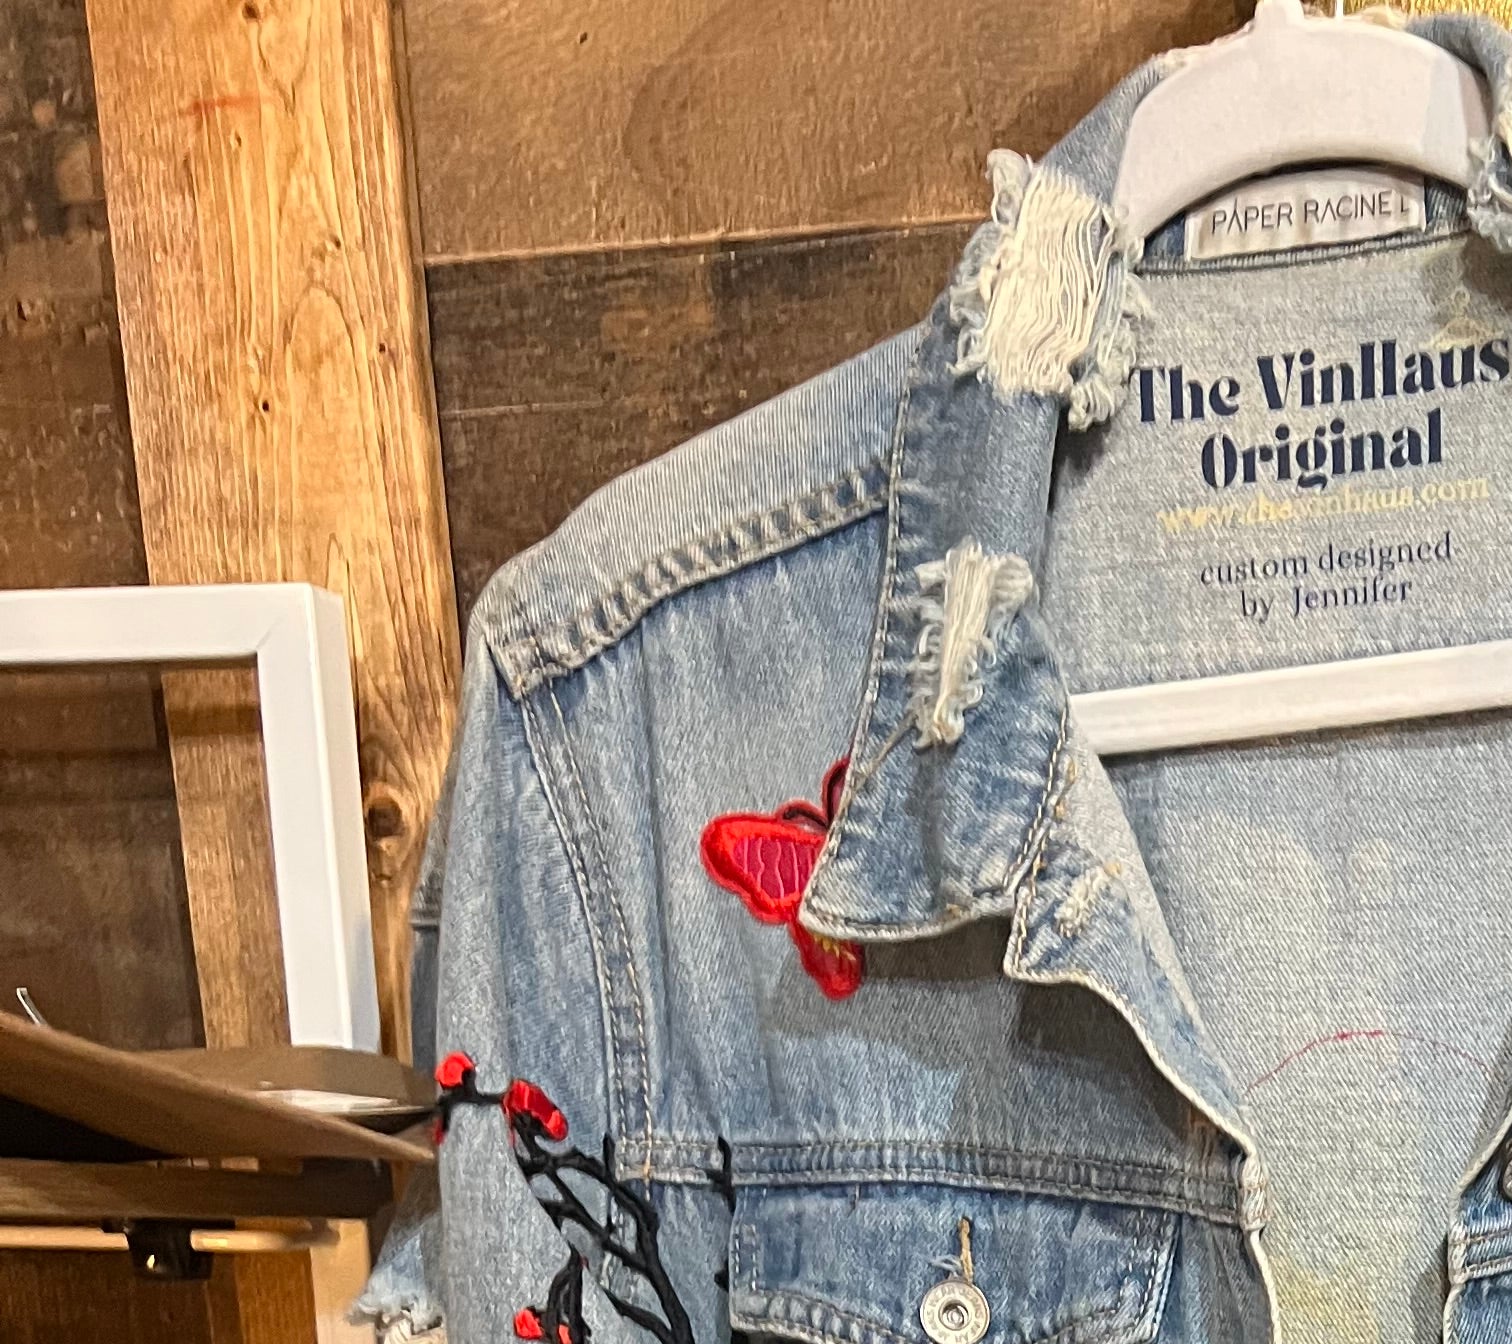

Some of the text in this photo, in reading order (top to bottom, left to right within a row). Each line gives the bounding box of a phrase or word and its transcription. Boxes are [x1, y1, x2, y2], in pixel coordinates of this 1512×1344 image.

[1211, 197, 1294, 236] PAPER
[1303, 188, 1393, 226] RACINE
[1127, 364, 1241, 424] The
[1200, 406, 1443, 491] Original
[1199, 529, 1453, 587] custom designed
[1240, 575, 1414, 625] by Jennifer
